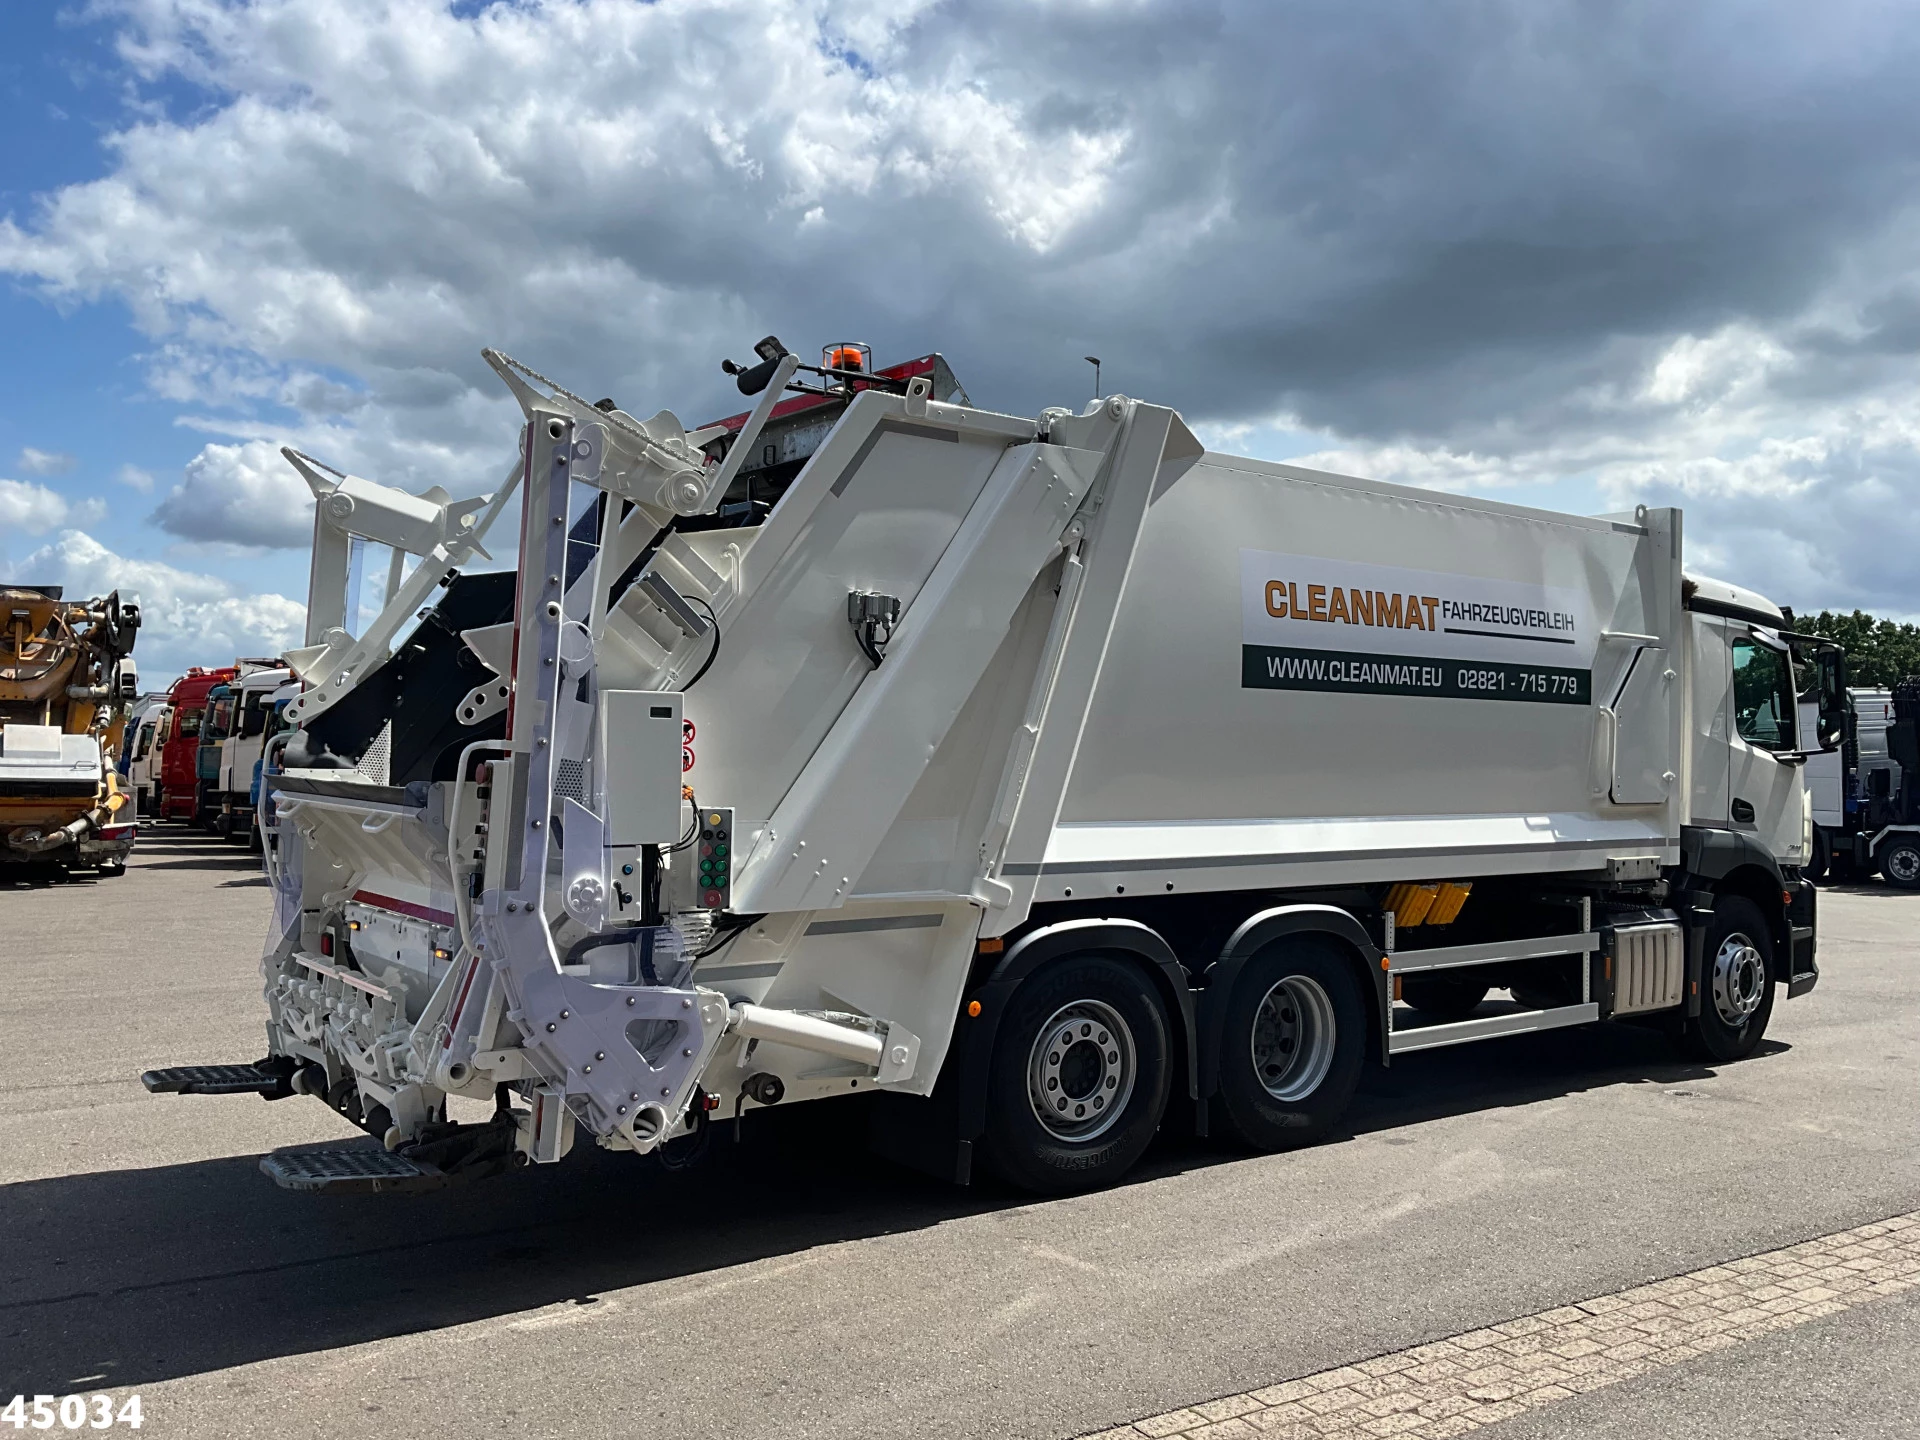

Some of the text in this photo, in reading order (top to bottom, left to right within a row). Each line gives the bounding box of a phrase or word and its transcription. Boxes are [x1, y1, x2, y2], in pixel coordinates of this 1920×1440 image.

[1264, 579, 1575, 632] CLEANMAT FAHRZEUGVERLEIH
[1266, 656, 1442, 687] WWW.CLEANMAT.EU
[1457, 669, 1505, 691] 02821
[1519, 673, 1547, 693] 715
[1551, 675, 1577, 695] 779
